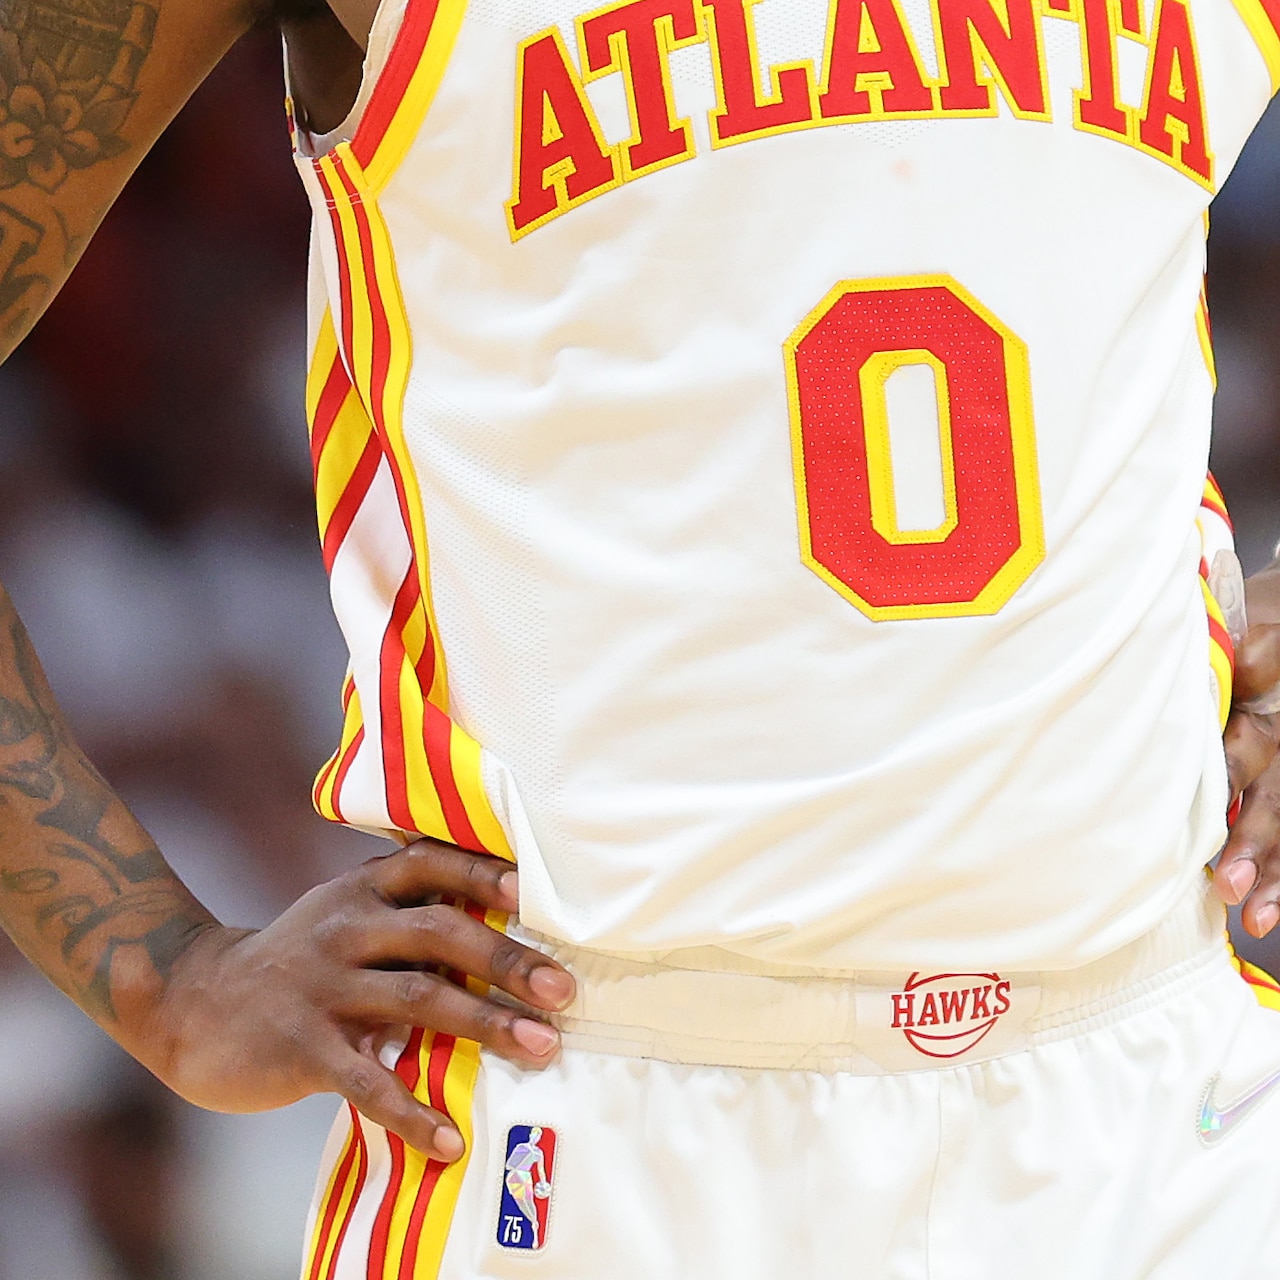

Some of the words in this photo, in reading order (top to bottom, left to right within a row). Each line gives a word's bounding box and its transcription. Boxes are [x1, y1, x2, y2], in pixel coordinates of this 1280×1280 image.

[782, 273, 1047, 622] 0
[891, 980, 1011, 1028] HAWKS
[503, 1215, 524, 1244] 75
